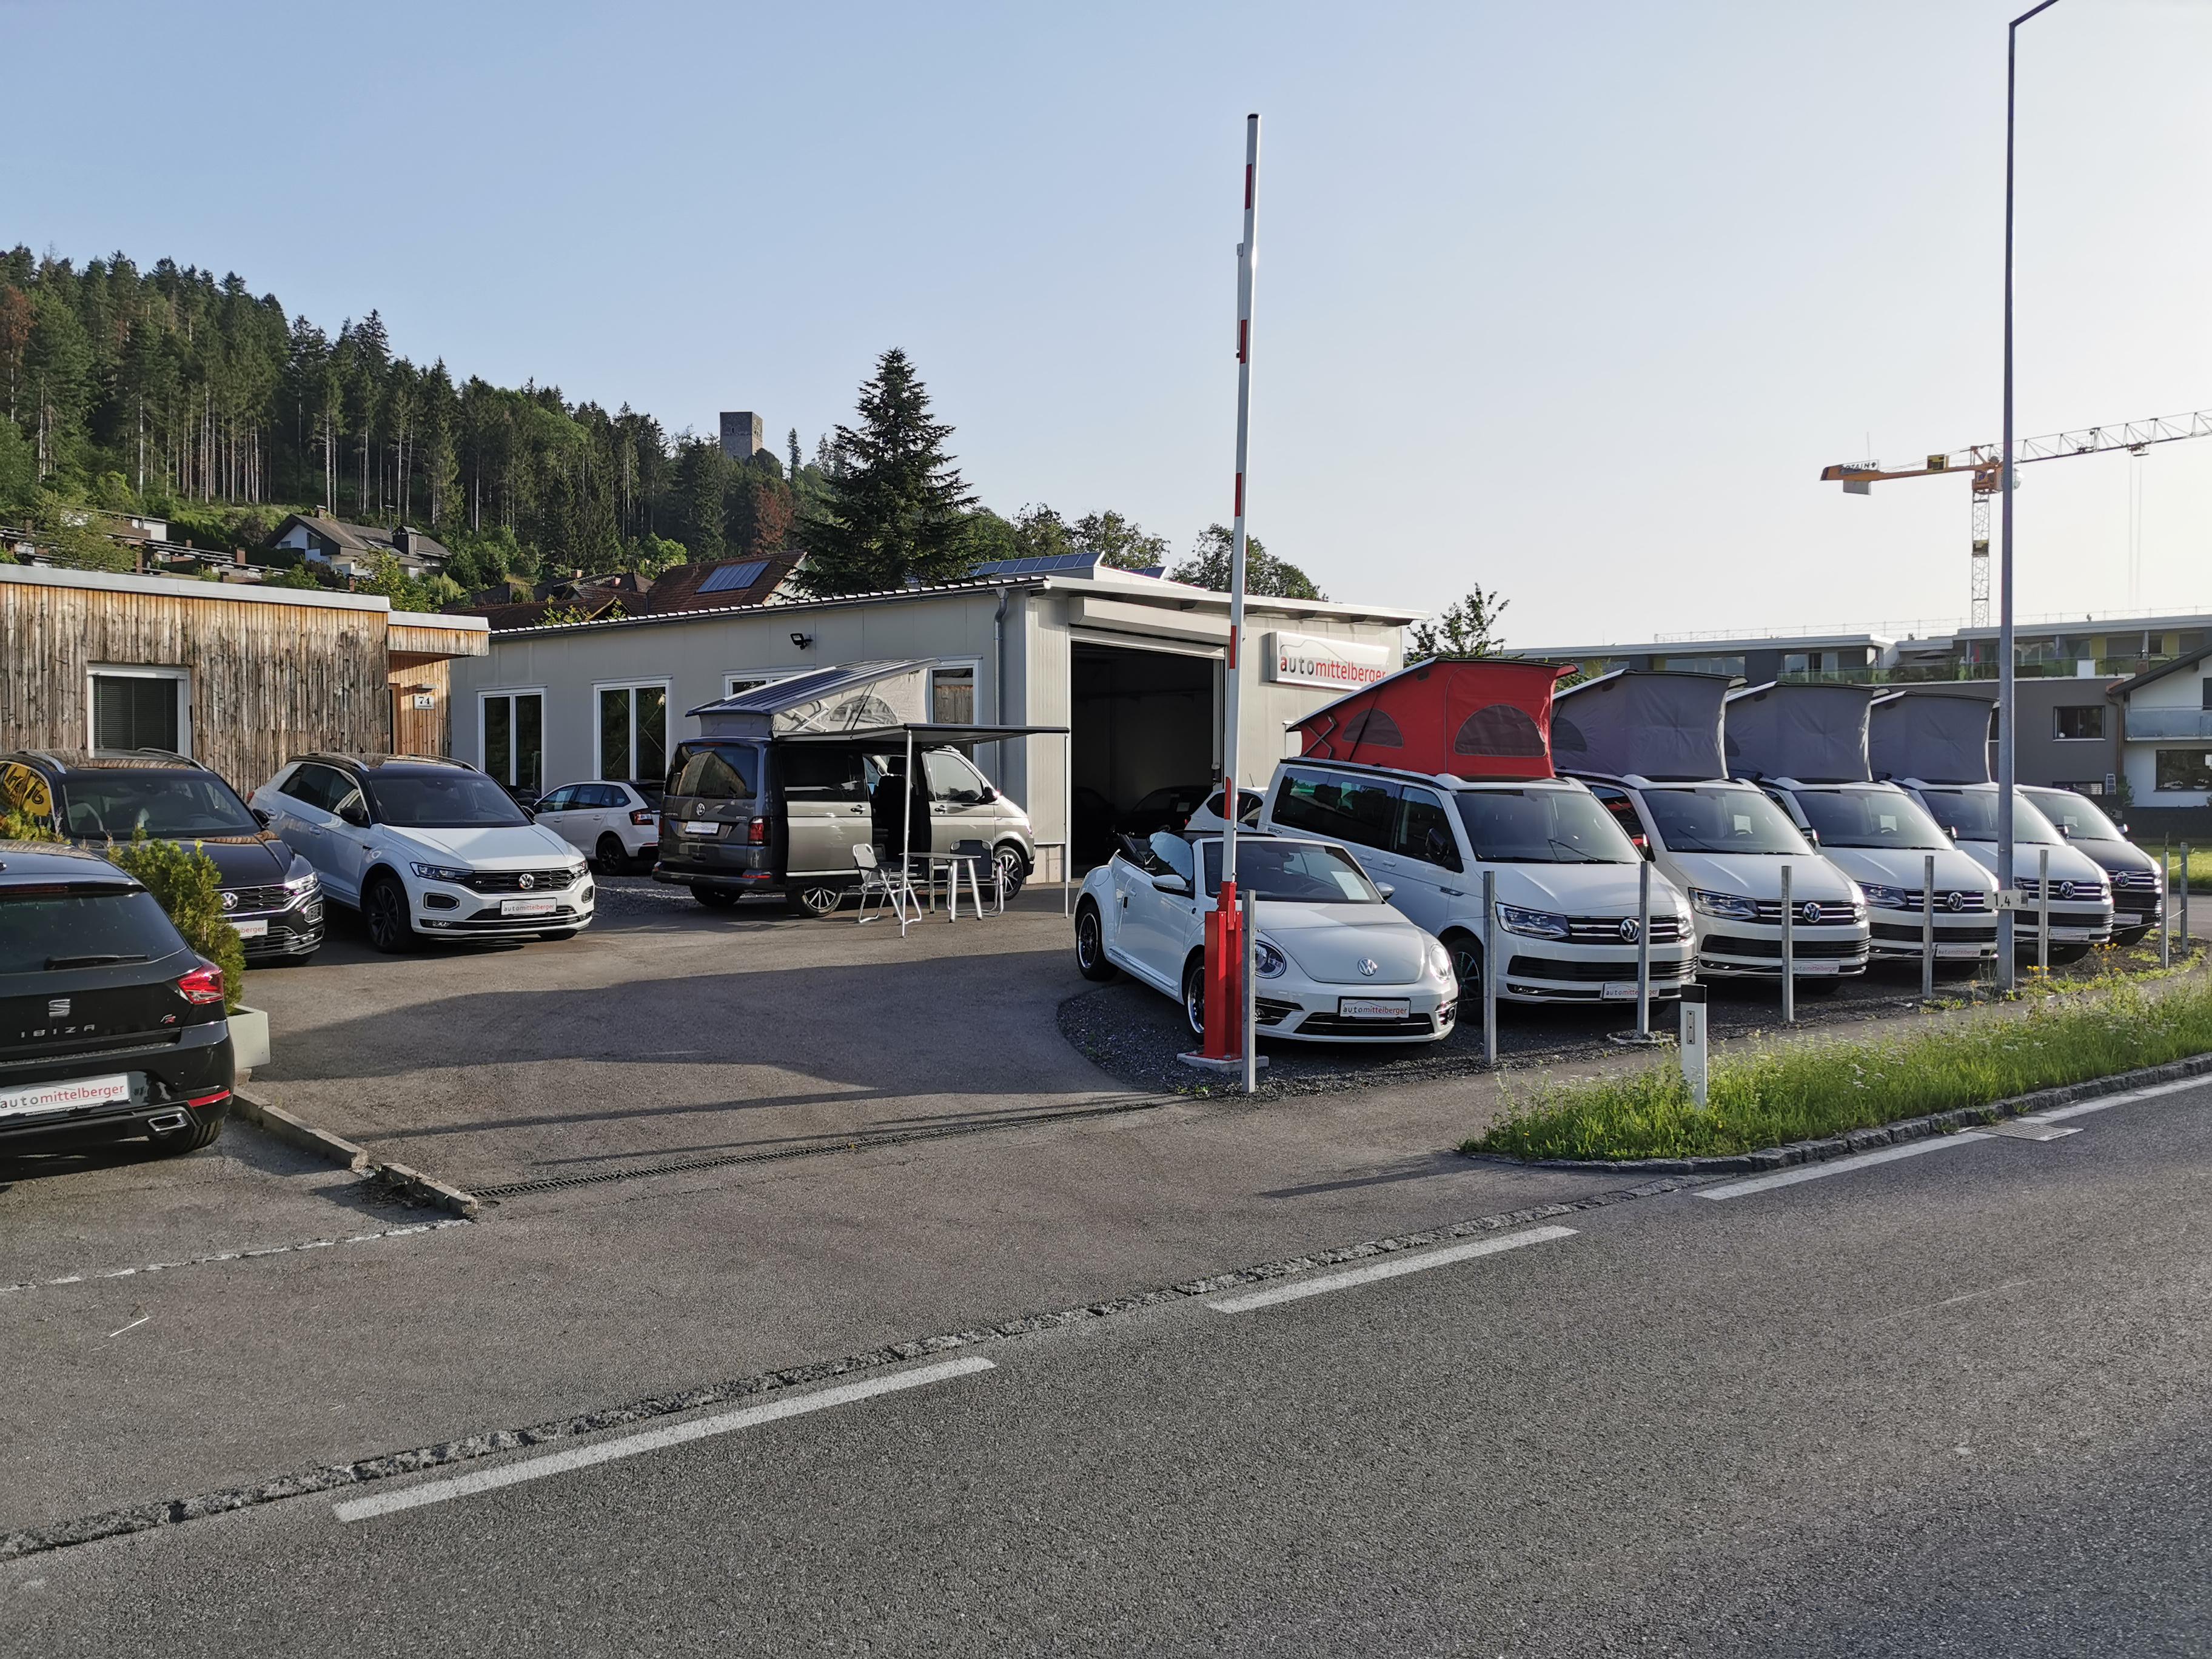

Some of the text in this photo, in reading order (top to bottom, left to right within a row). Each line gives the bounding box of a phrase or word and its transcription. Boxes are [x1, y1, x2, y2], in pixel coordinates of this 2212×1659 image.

[1280, 655, 1386, 683] automittelberger
[1993, 893, 2011, 907] 1,4
[1343, 1005, 1407, 1016] automittelberger
[21, 1024, 95, 1038] IBIZA
[0, 1085, 125, 1108] automittelberger
